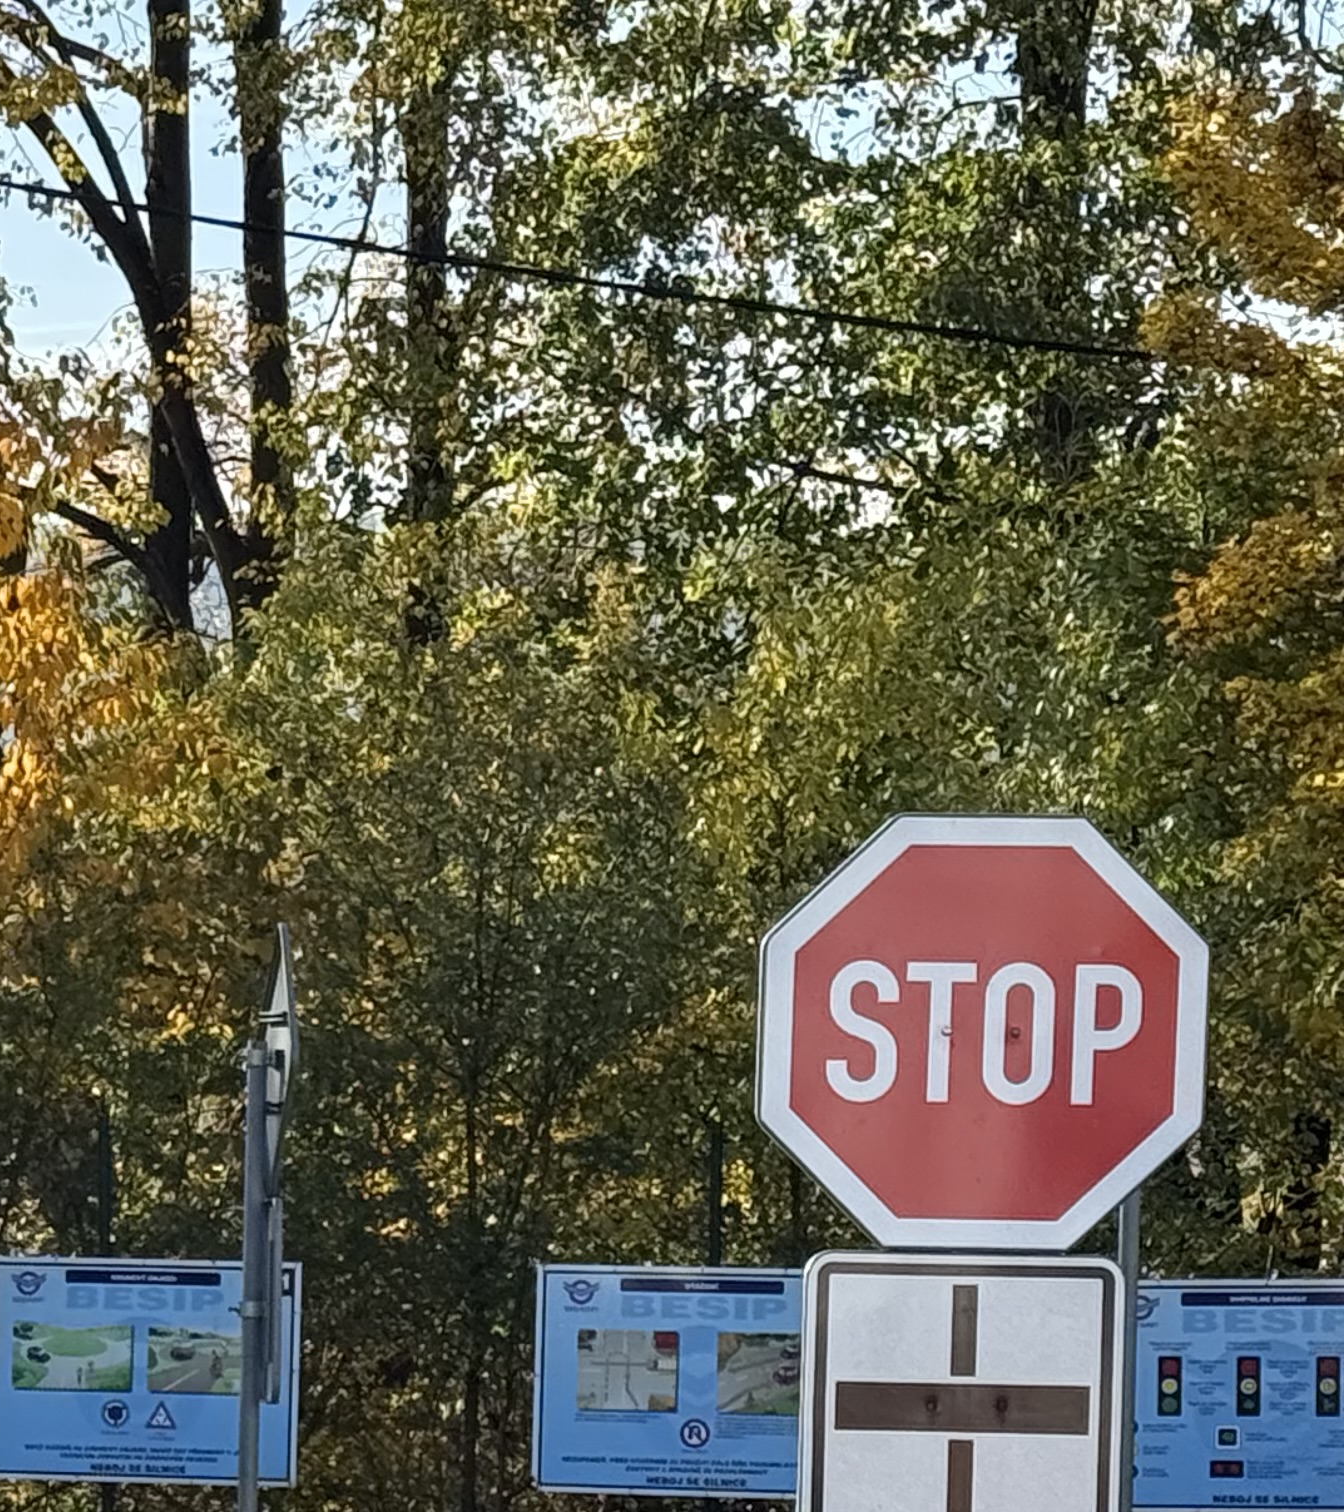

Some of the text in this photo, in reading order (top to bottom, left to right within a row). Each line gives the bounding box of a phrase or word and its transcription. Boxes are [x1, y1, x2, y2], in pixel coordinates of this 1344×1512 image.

[825, 959, 1143, 1106] STOP
[65, 1286, 224, 1312] BESIP
[621, 1295, 788, 1321] BESIP
